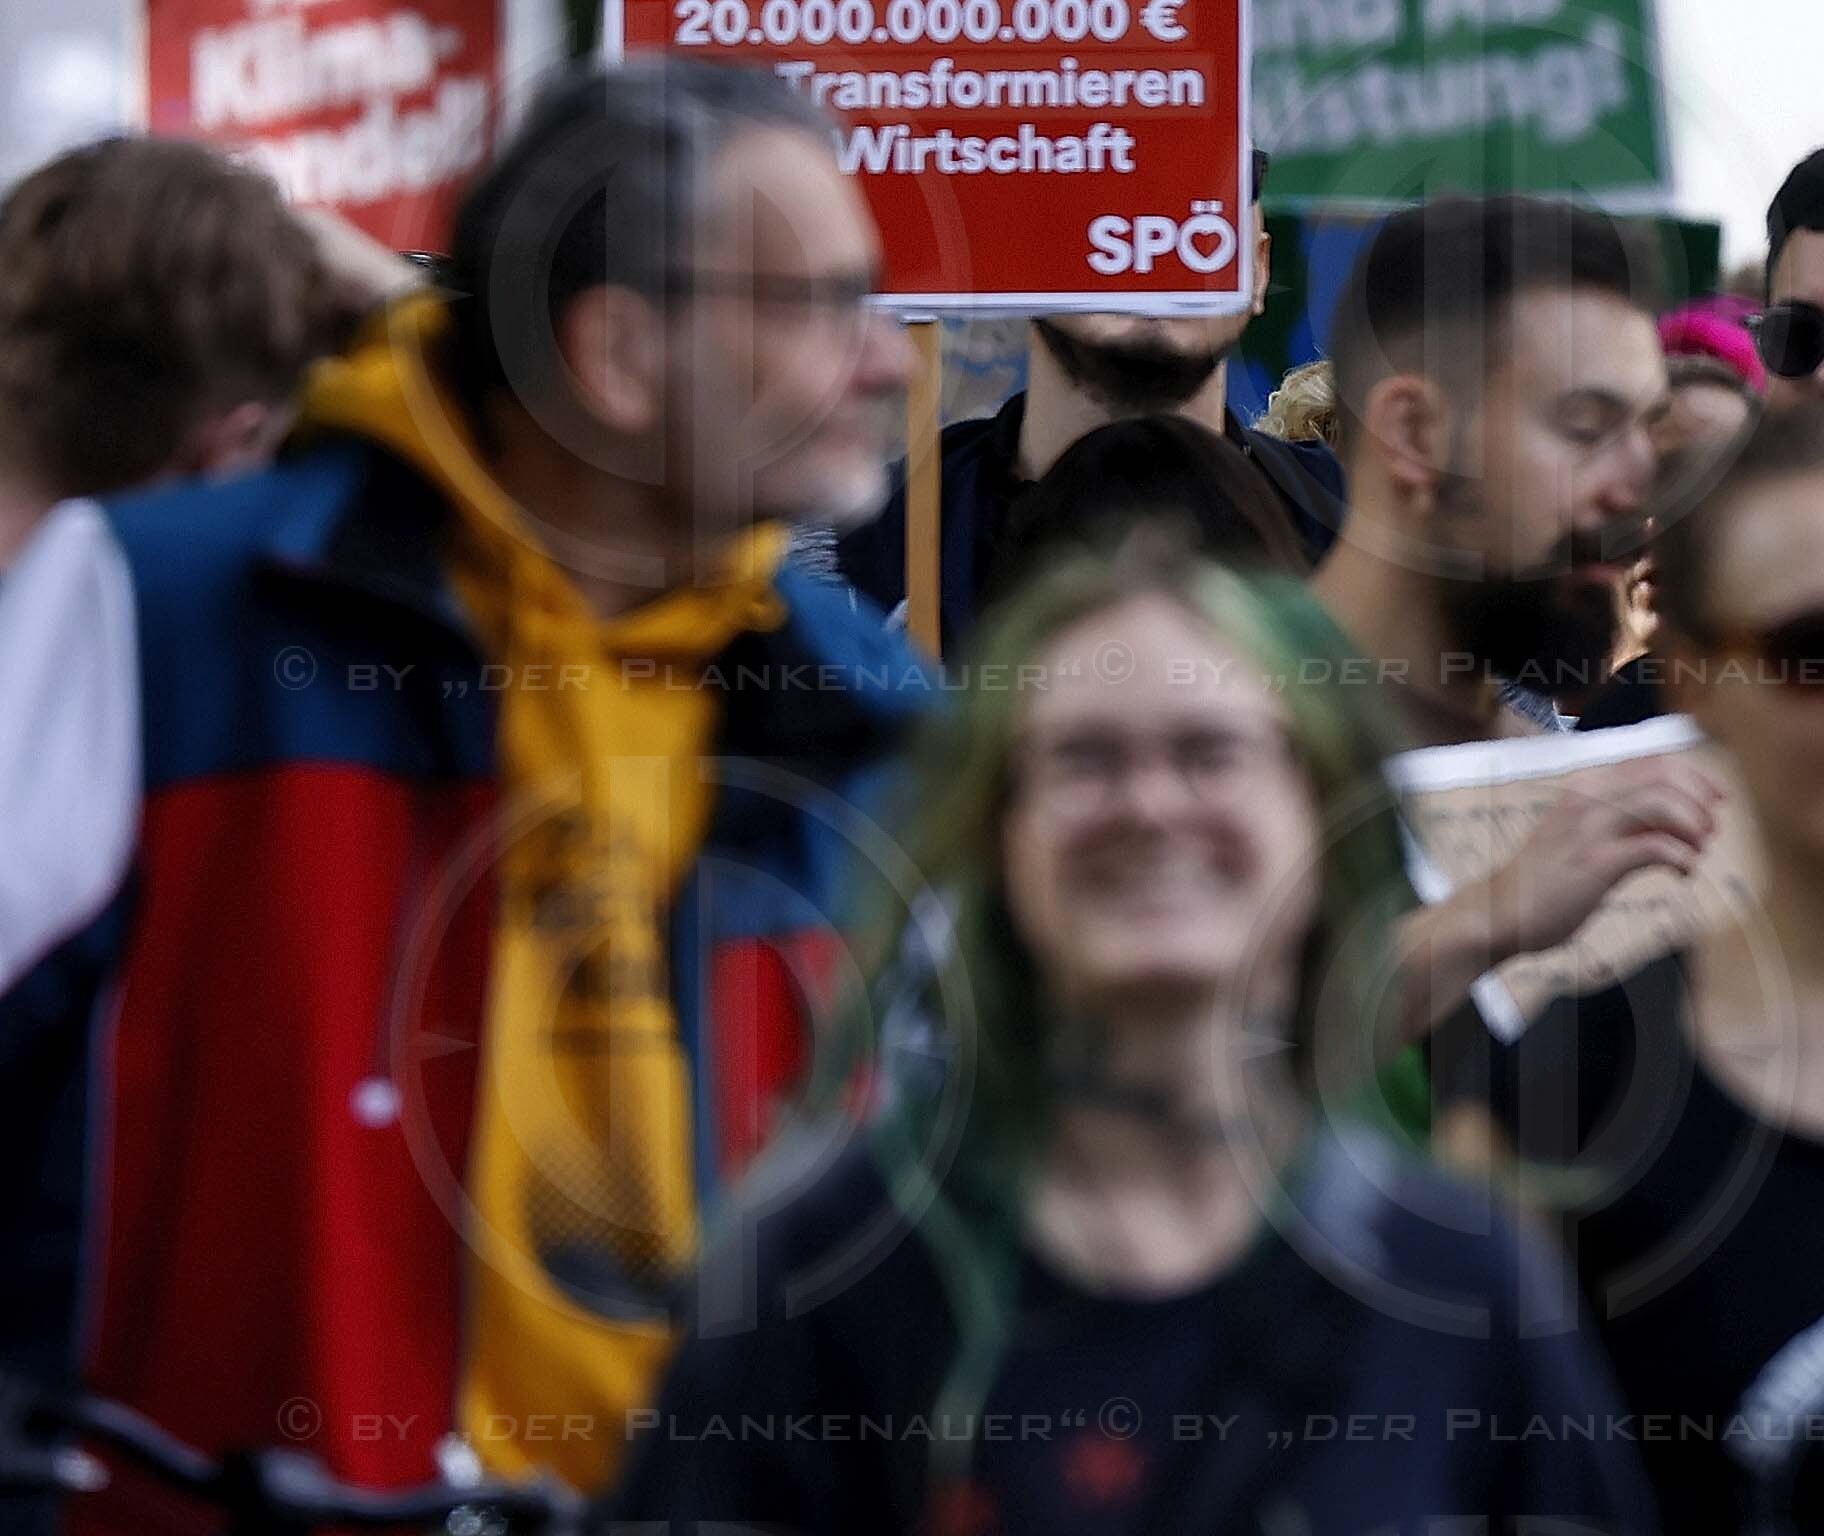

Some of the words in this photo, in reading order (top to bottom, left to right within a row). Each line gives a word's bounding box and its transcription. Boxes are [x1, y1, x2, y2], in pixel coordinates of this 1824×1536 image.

[776, 58, 1203, 109] Transformieren
[835, 124, 1135, 172] Wirtschaft
[1087, 202, 1234, 274] SPÖ
